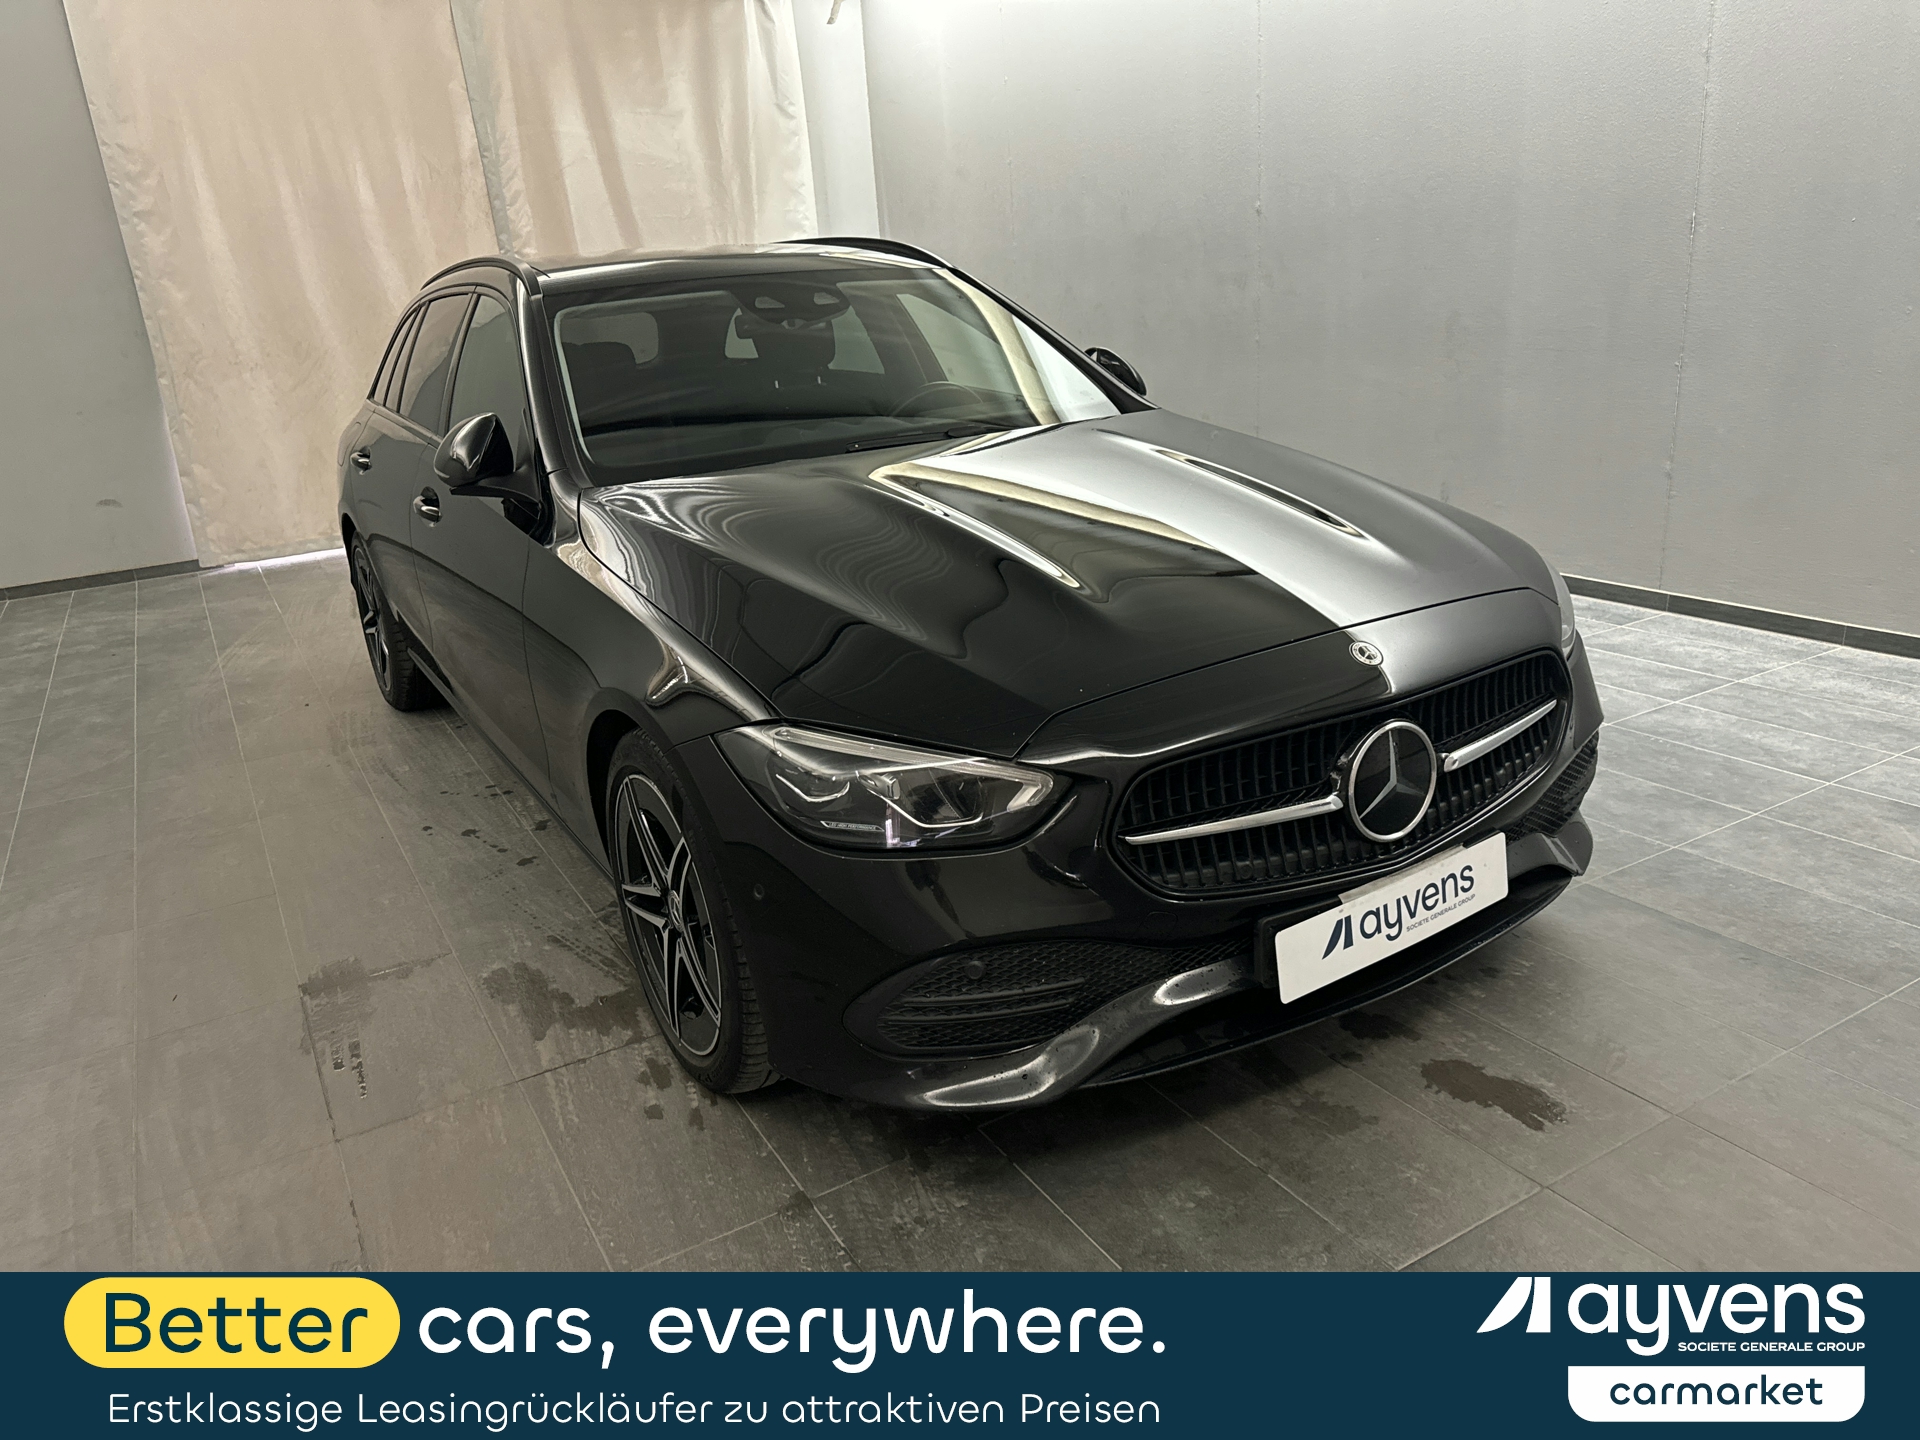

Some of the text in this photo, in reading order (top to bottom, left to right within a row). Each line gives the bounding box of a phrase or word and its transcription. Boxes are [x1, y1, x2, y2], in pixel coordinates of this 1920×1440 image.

[1360, 865, 1475, 941] ayvens
[1406, 894, 1476, 932] SOCIETE GENERALE GROUP
